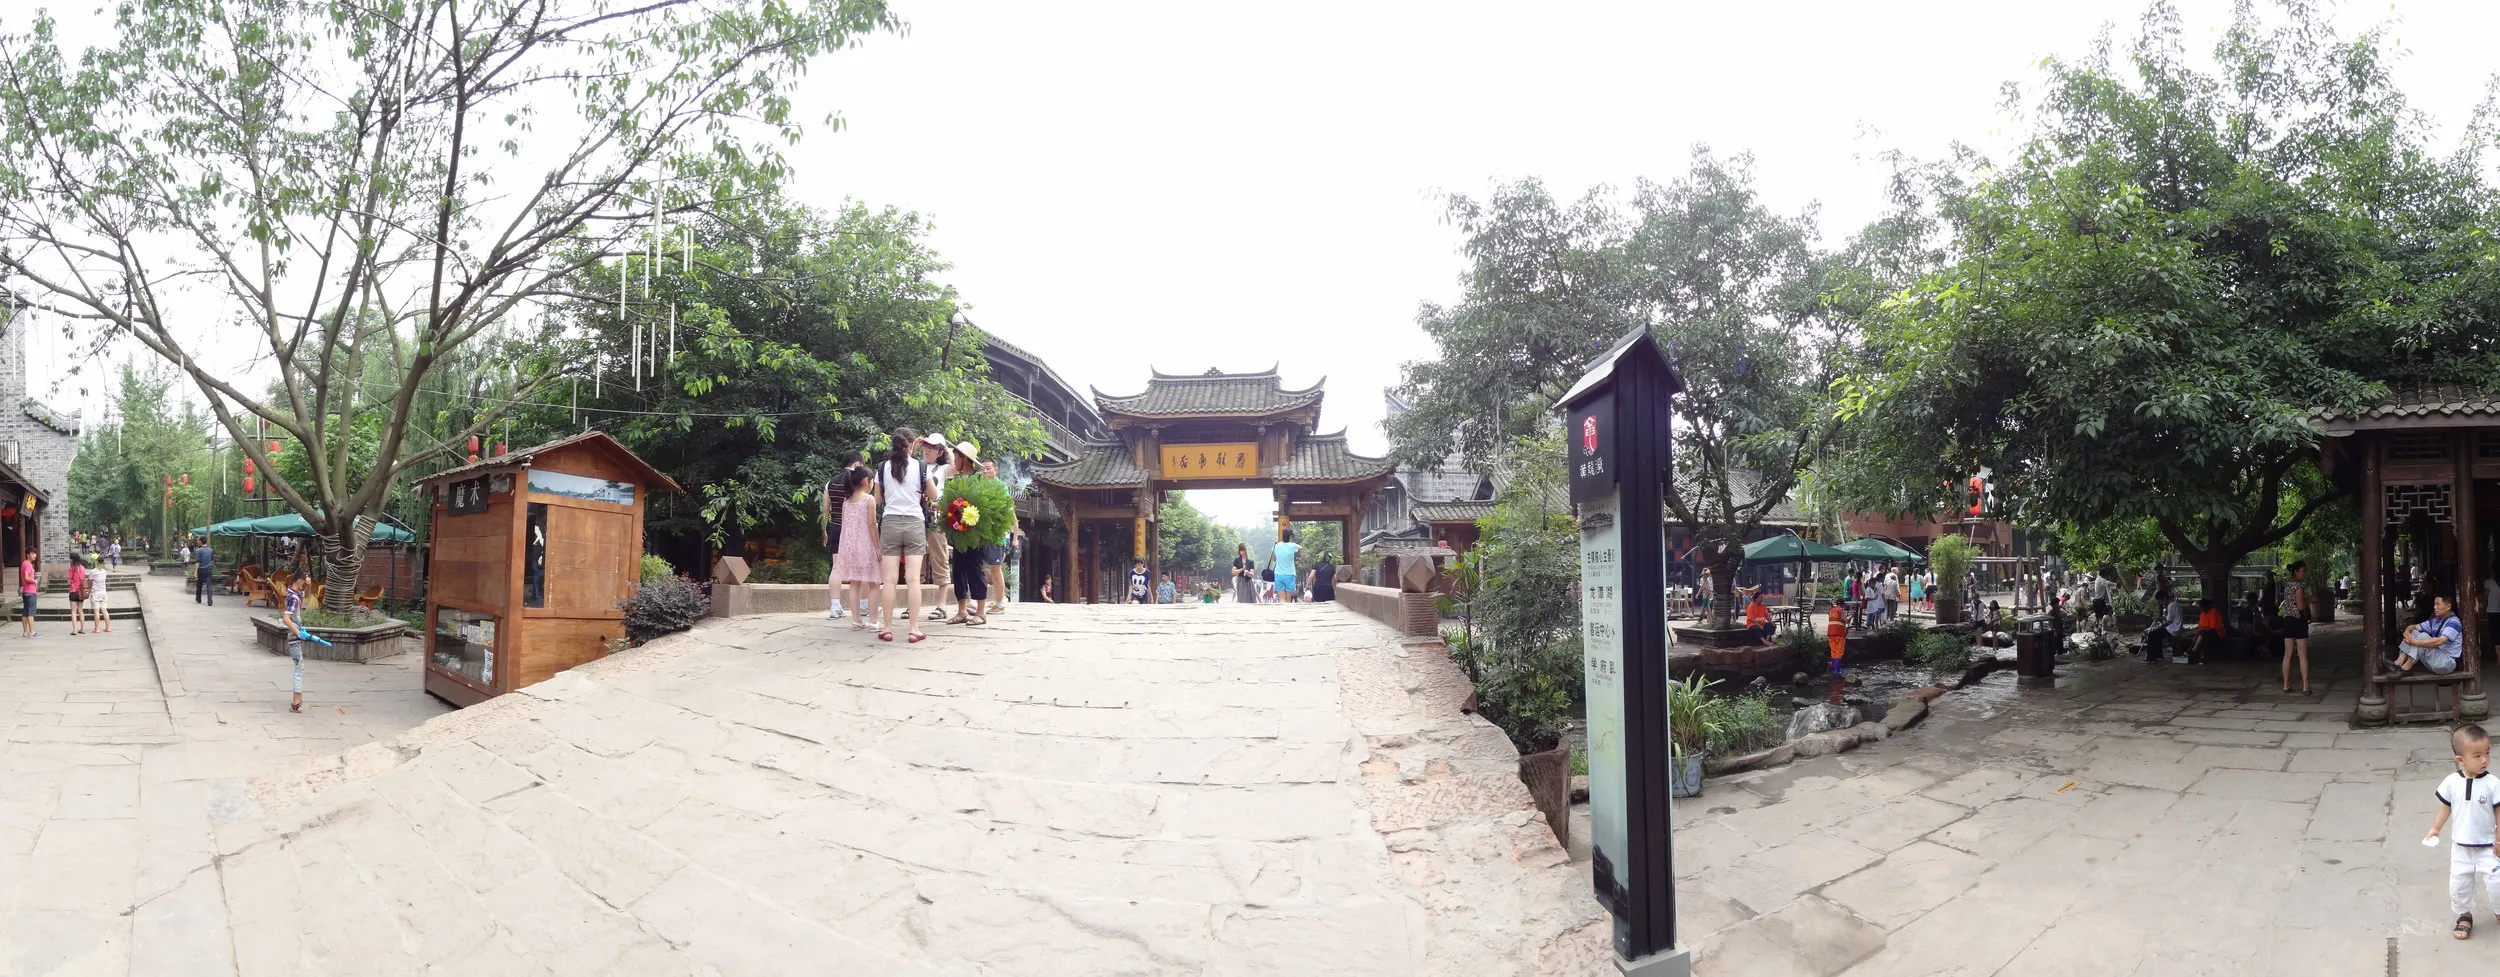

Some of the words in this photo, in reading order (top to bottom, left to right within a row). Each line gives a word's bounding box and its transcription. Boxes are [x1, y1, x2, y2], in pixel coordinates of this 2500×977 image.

[455, 480, 480, 508] 魔术
[1590, 622, 1610, 638] 客运中心
